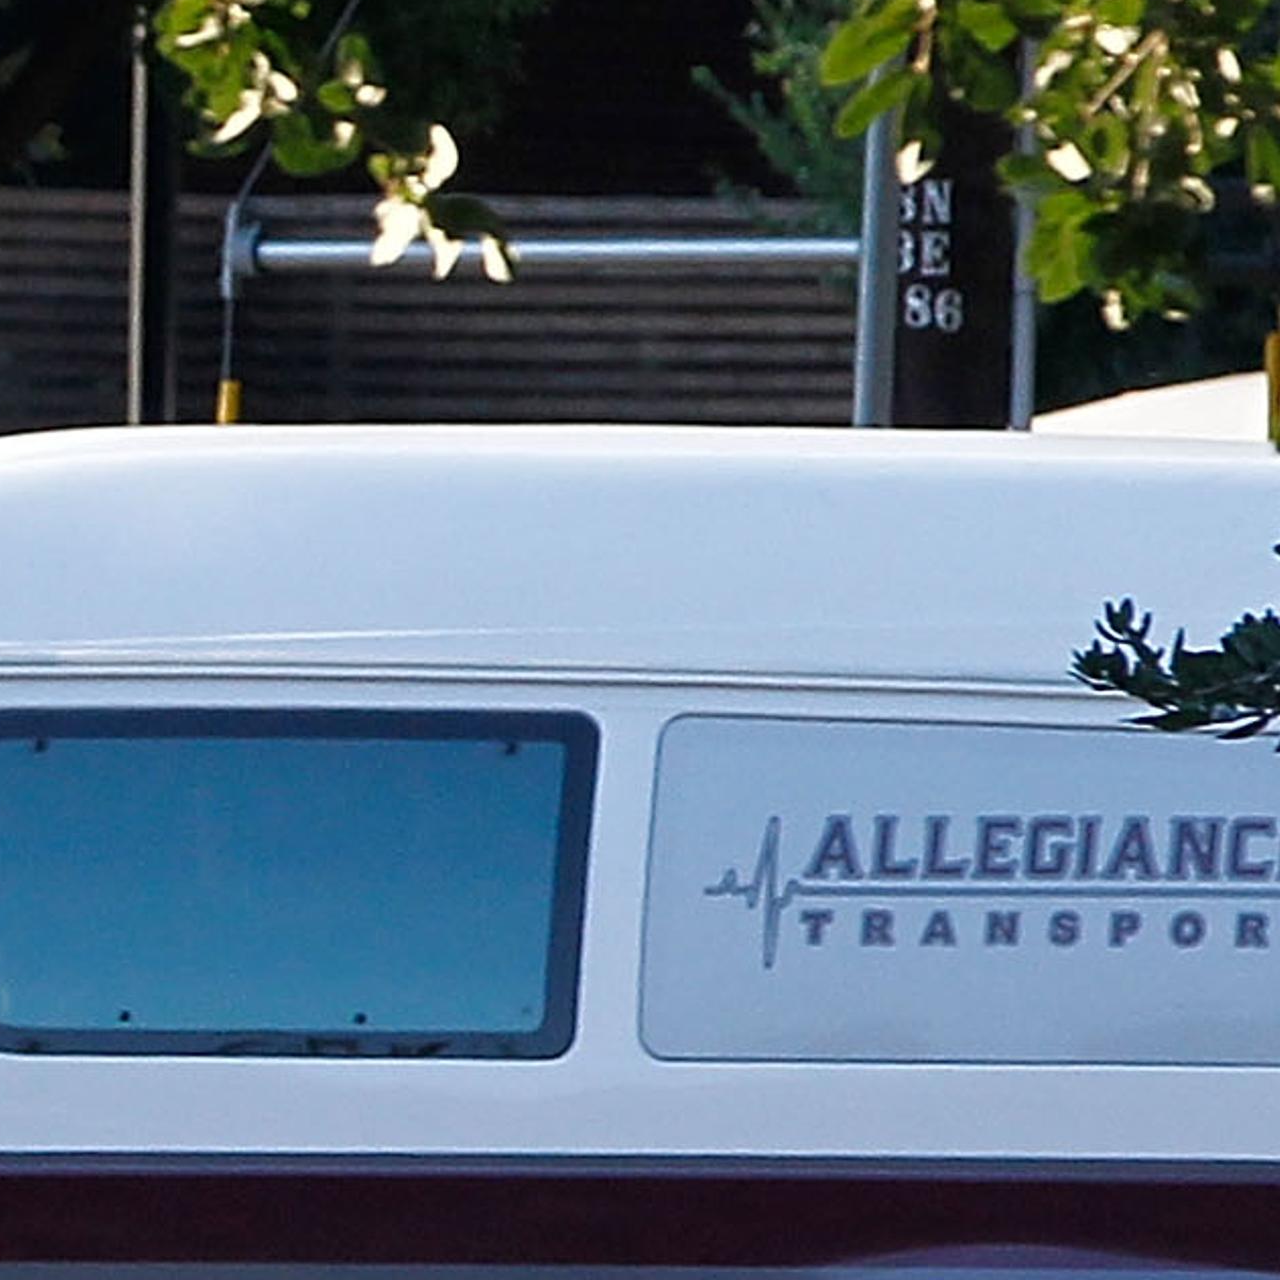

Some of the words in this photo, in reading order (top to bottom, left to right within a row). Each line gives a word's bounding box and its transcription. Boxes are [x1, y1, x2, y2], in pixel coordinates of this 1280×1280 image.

[904, 282, 964, 334] 86
[803, 815, 1280, 881] ALLEGIANC
[800, 909, 1269, 948] TRANSPOR
